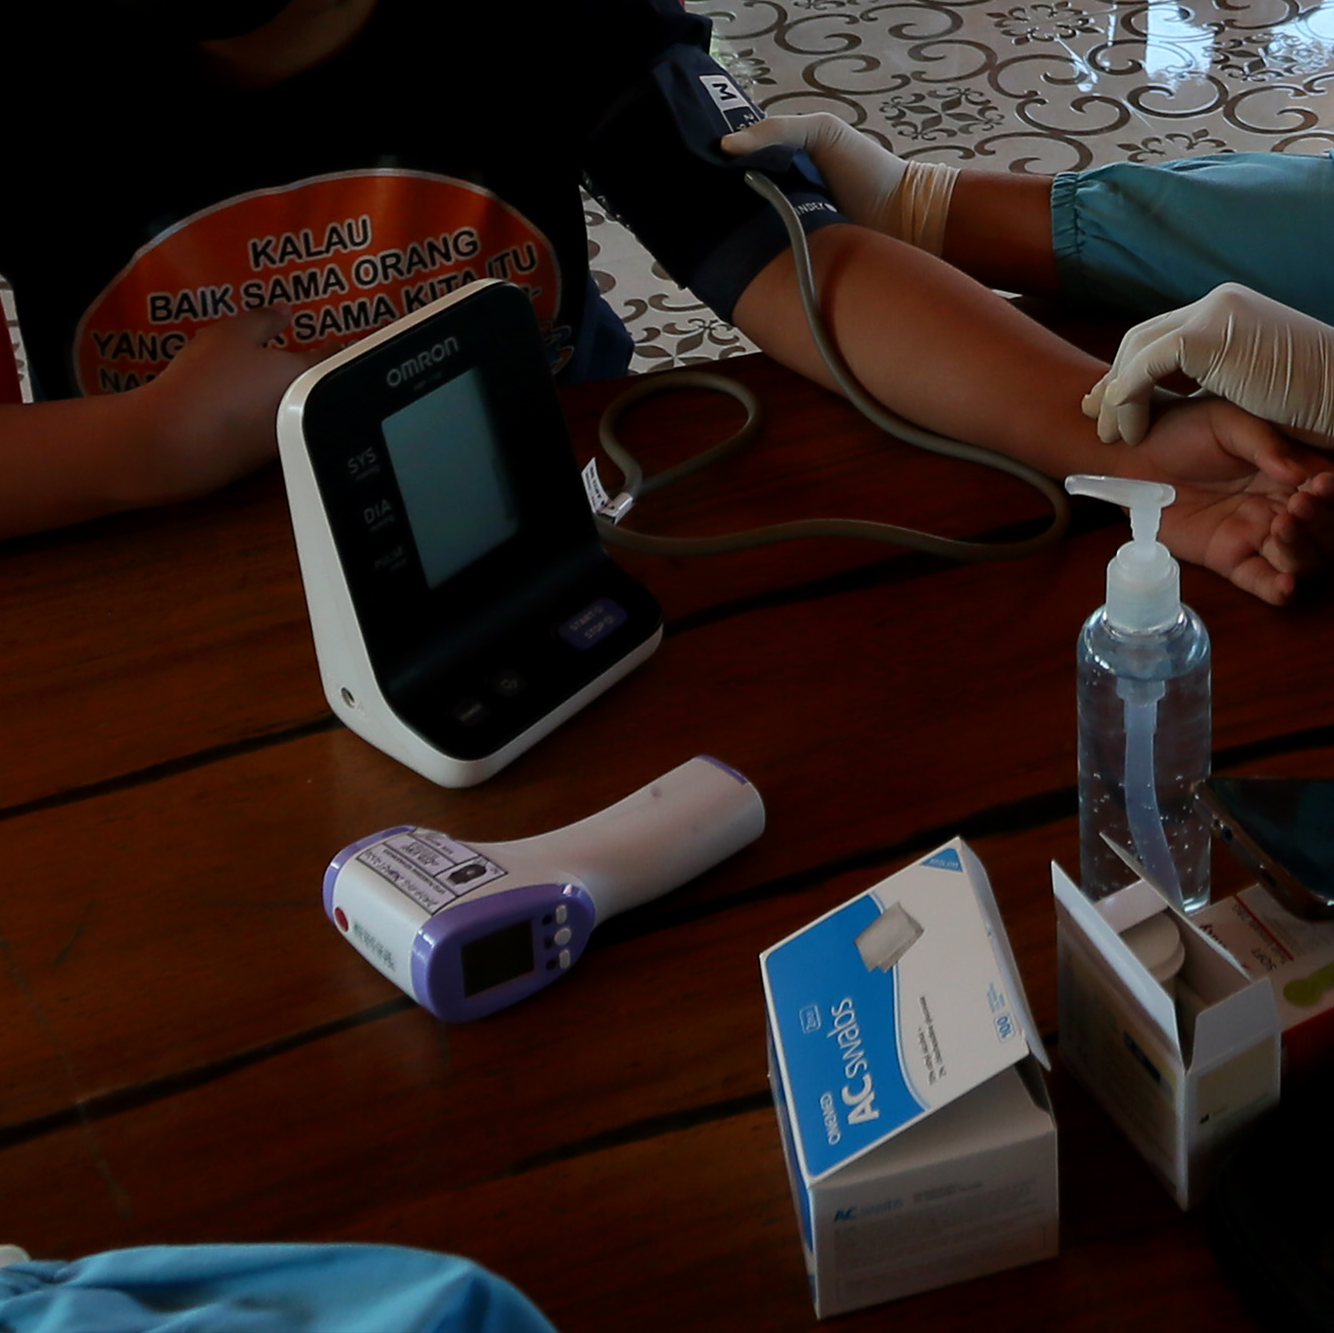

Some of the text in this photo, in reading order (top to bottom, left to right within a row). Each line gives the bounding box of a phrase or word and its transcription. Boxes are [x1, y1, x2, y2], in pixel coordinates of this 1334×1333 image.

[712, 82, 737, 102] M
[251, 217, 369, 269] KALAU
[149, 228, 480, 323] BAIK SAMA ORANG
[293, 300, 396, 341] SAMA
[487, 244, 538, 280] ITU
[384, 335, 460, 389] OMRON
[346, 444, 379, 476] SYS
[362, 497, 394, 526] DIA
[998, 1016, 1013, 1039] 100
